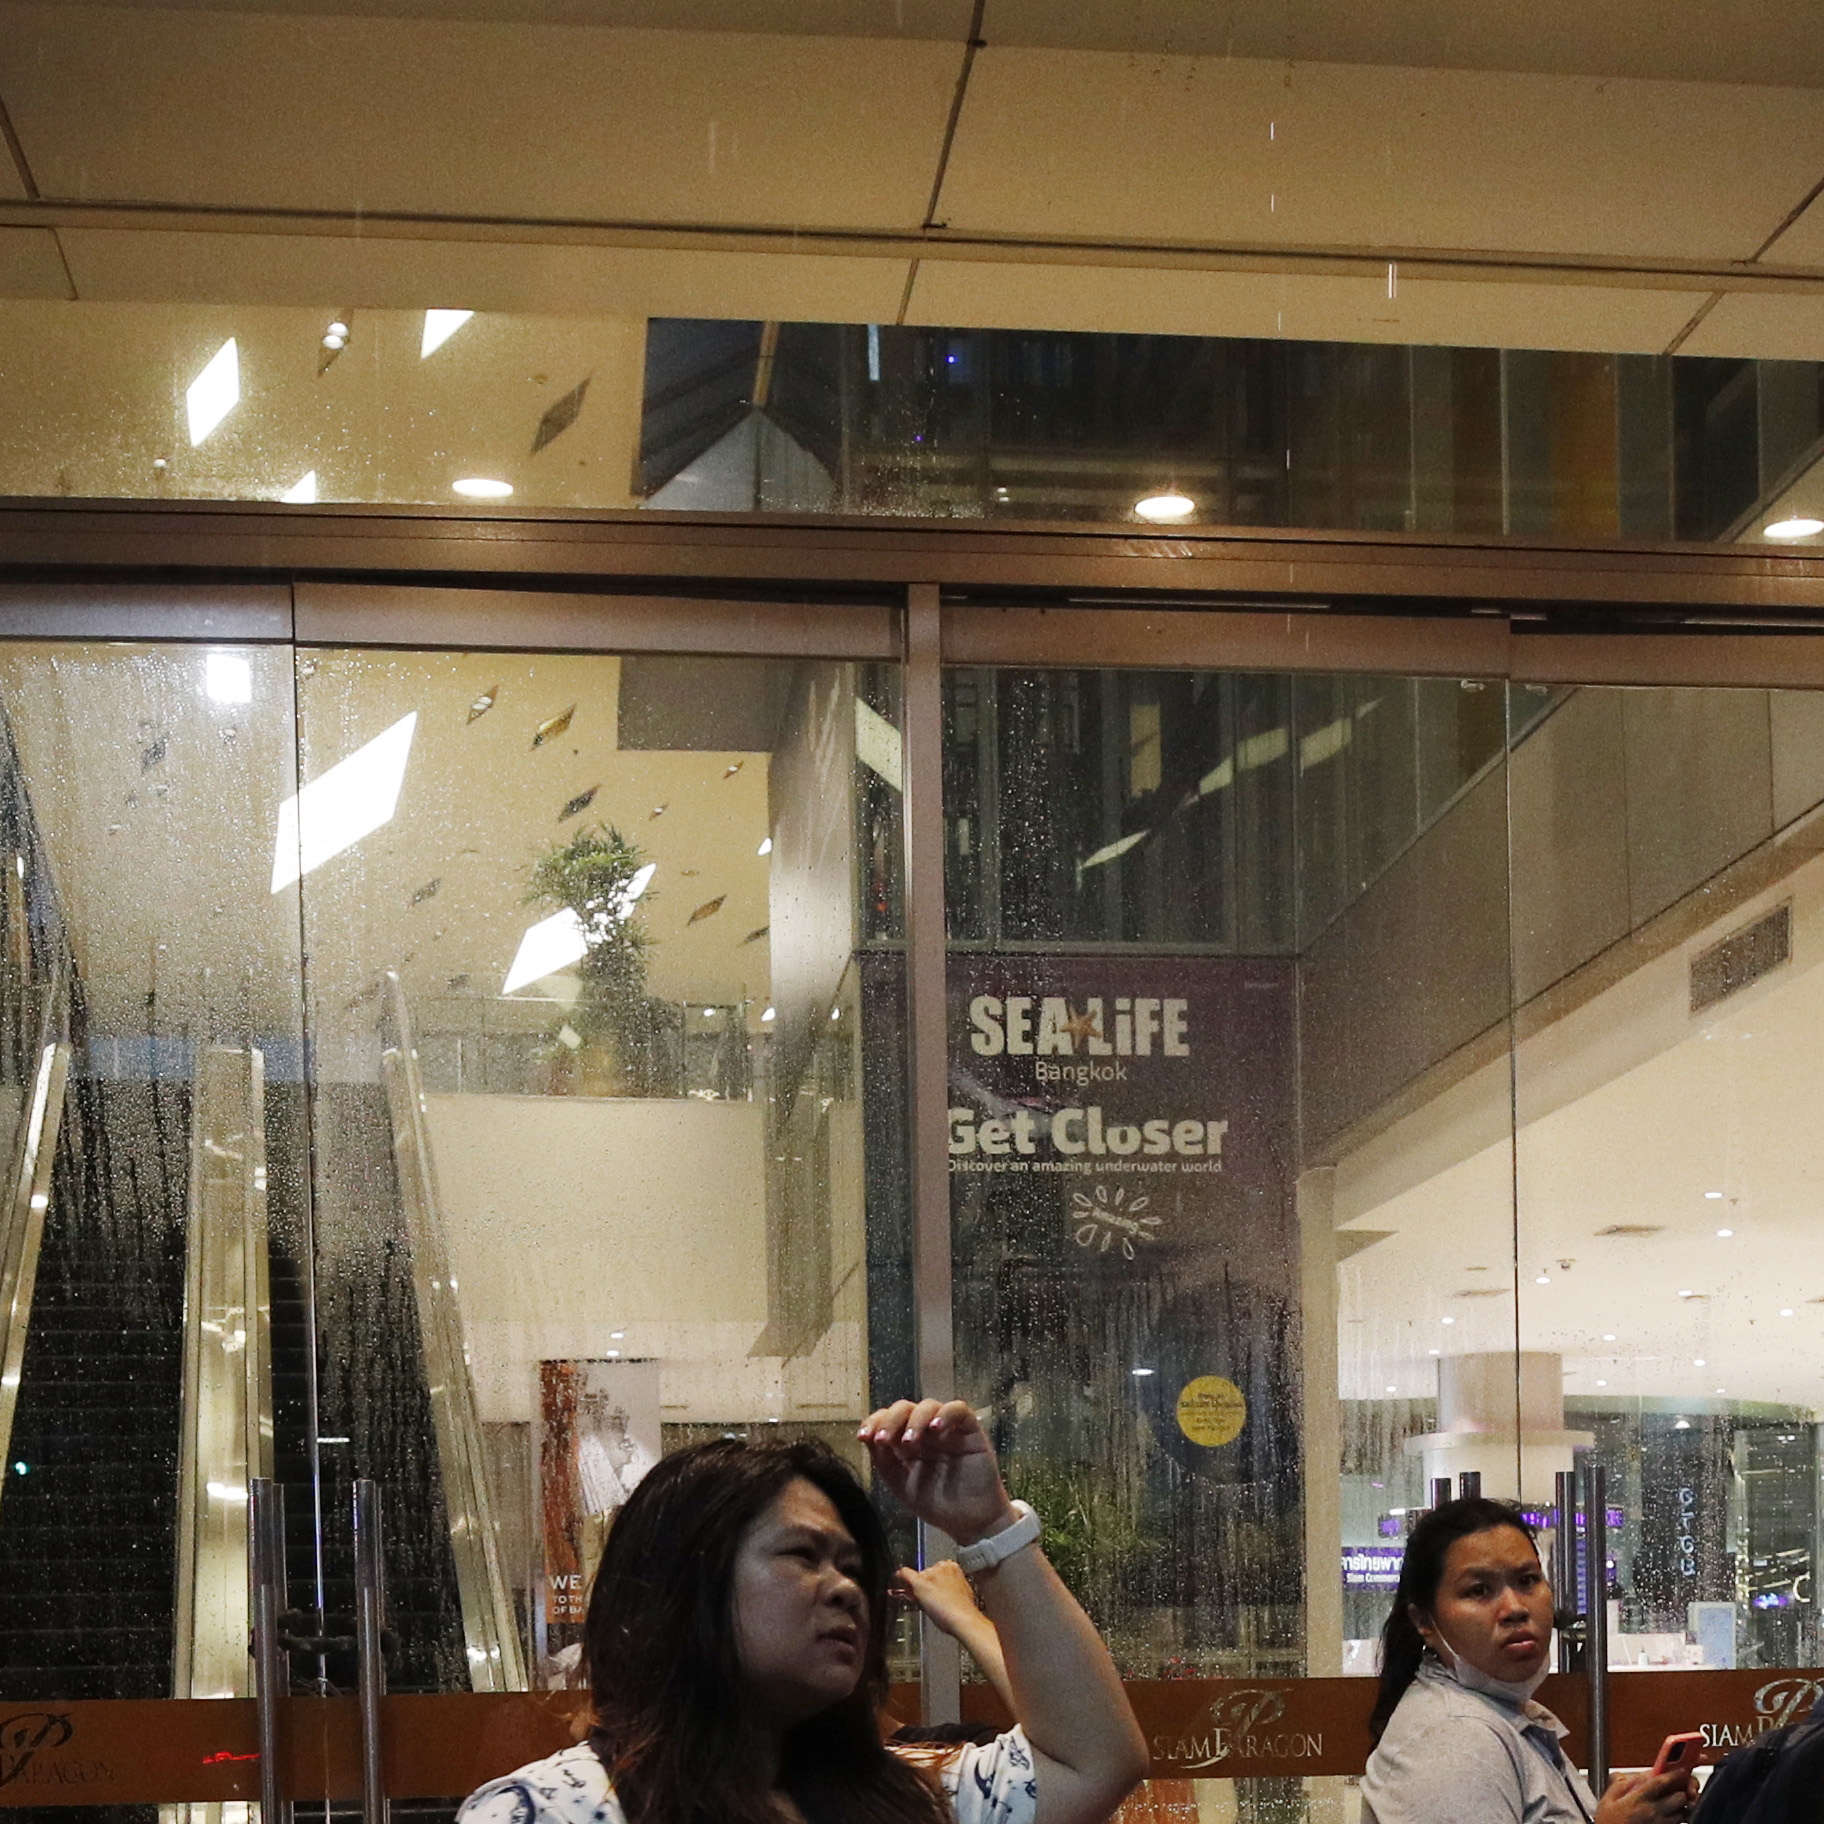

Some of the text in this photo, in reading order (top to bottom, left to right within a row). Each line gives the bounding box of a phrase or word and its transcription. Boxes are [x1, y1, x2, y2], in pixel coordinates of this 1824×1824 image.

[969, 996, 1073, 1056] SEA
[1035, 1061, 1127, 1086] Bangkok
[948, 1107, 1229, 1156] Get Closer
[949, 1159, 1222, 1175] Discover an amazing underwater world
